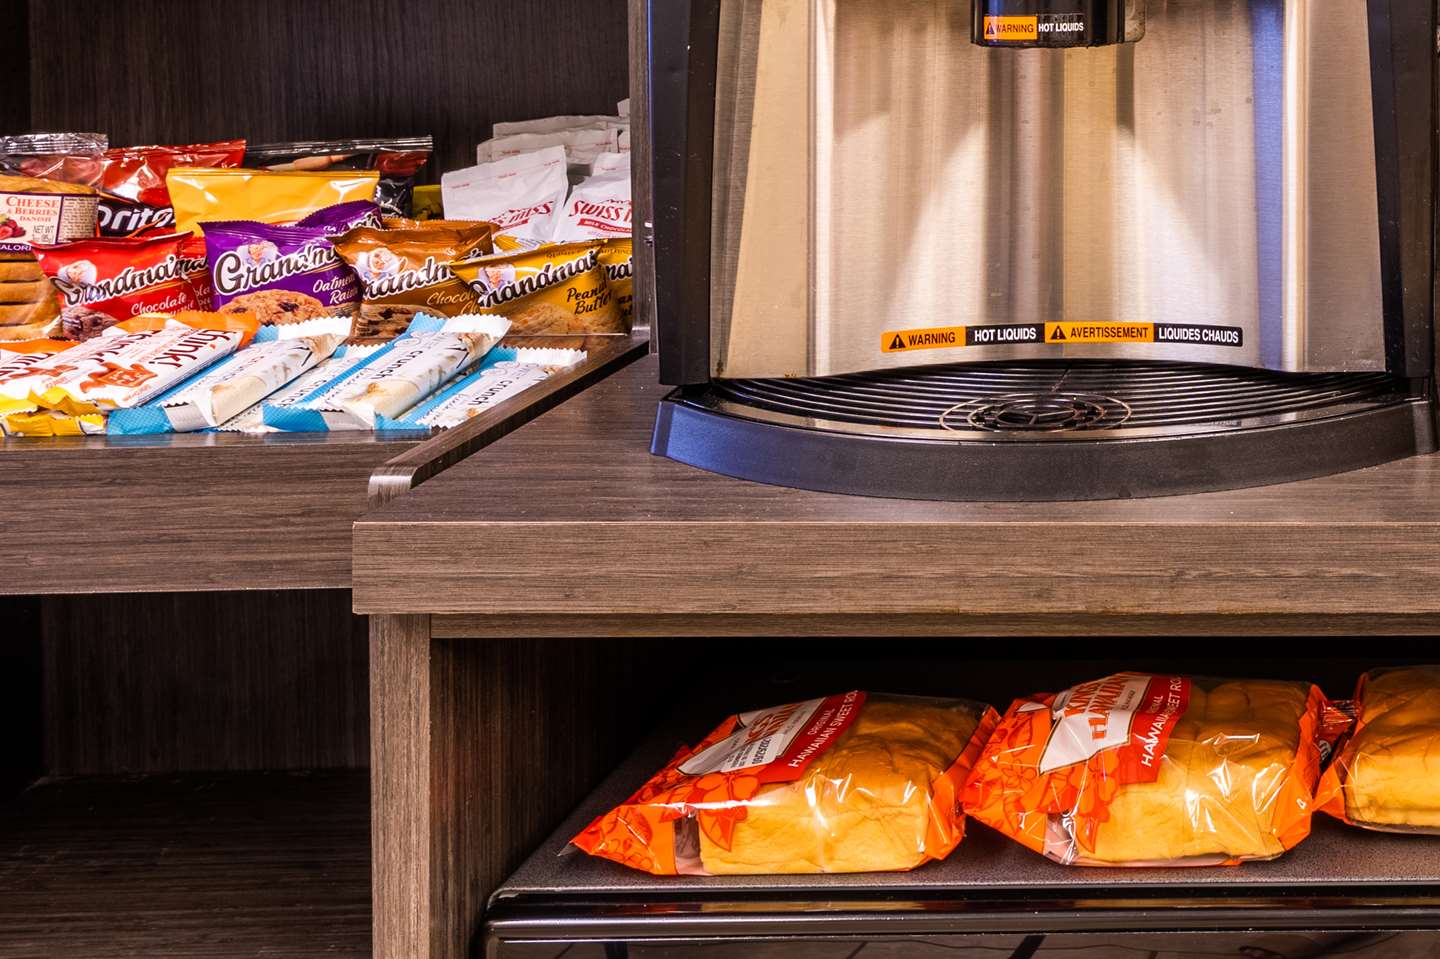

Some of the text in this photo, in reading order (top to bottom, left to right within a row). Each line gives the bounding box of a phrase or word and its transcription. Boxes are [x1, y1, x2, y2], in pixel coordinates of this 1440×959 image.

[996, 21, 1084, 34] WARNING HOT LIQUIDS
[6, 196, 59, 208] CHEESE
[15, 207, 58, 216] BERRIES
[908, 326, 1239, 346] WARNING HOT LIQUIDS AVERTISSEMENT LIQUIDES CHAUDS
